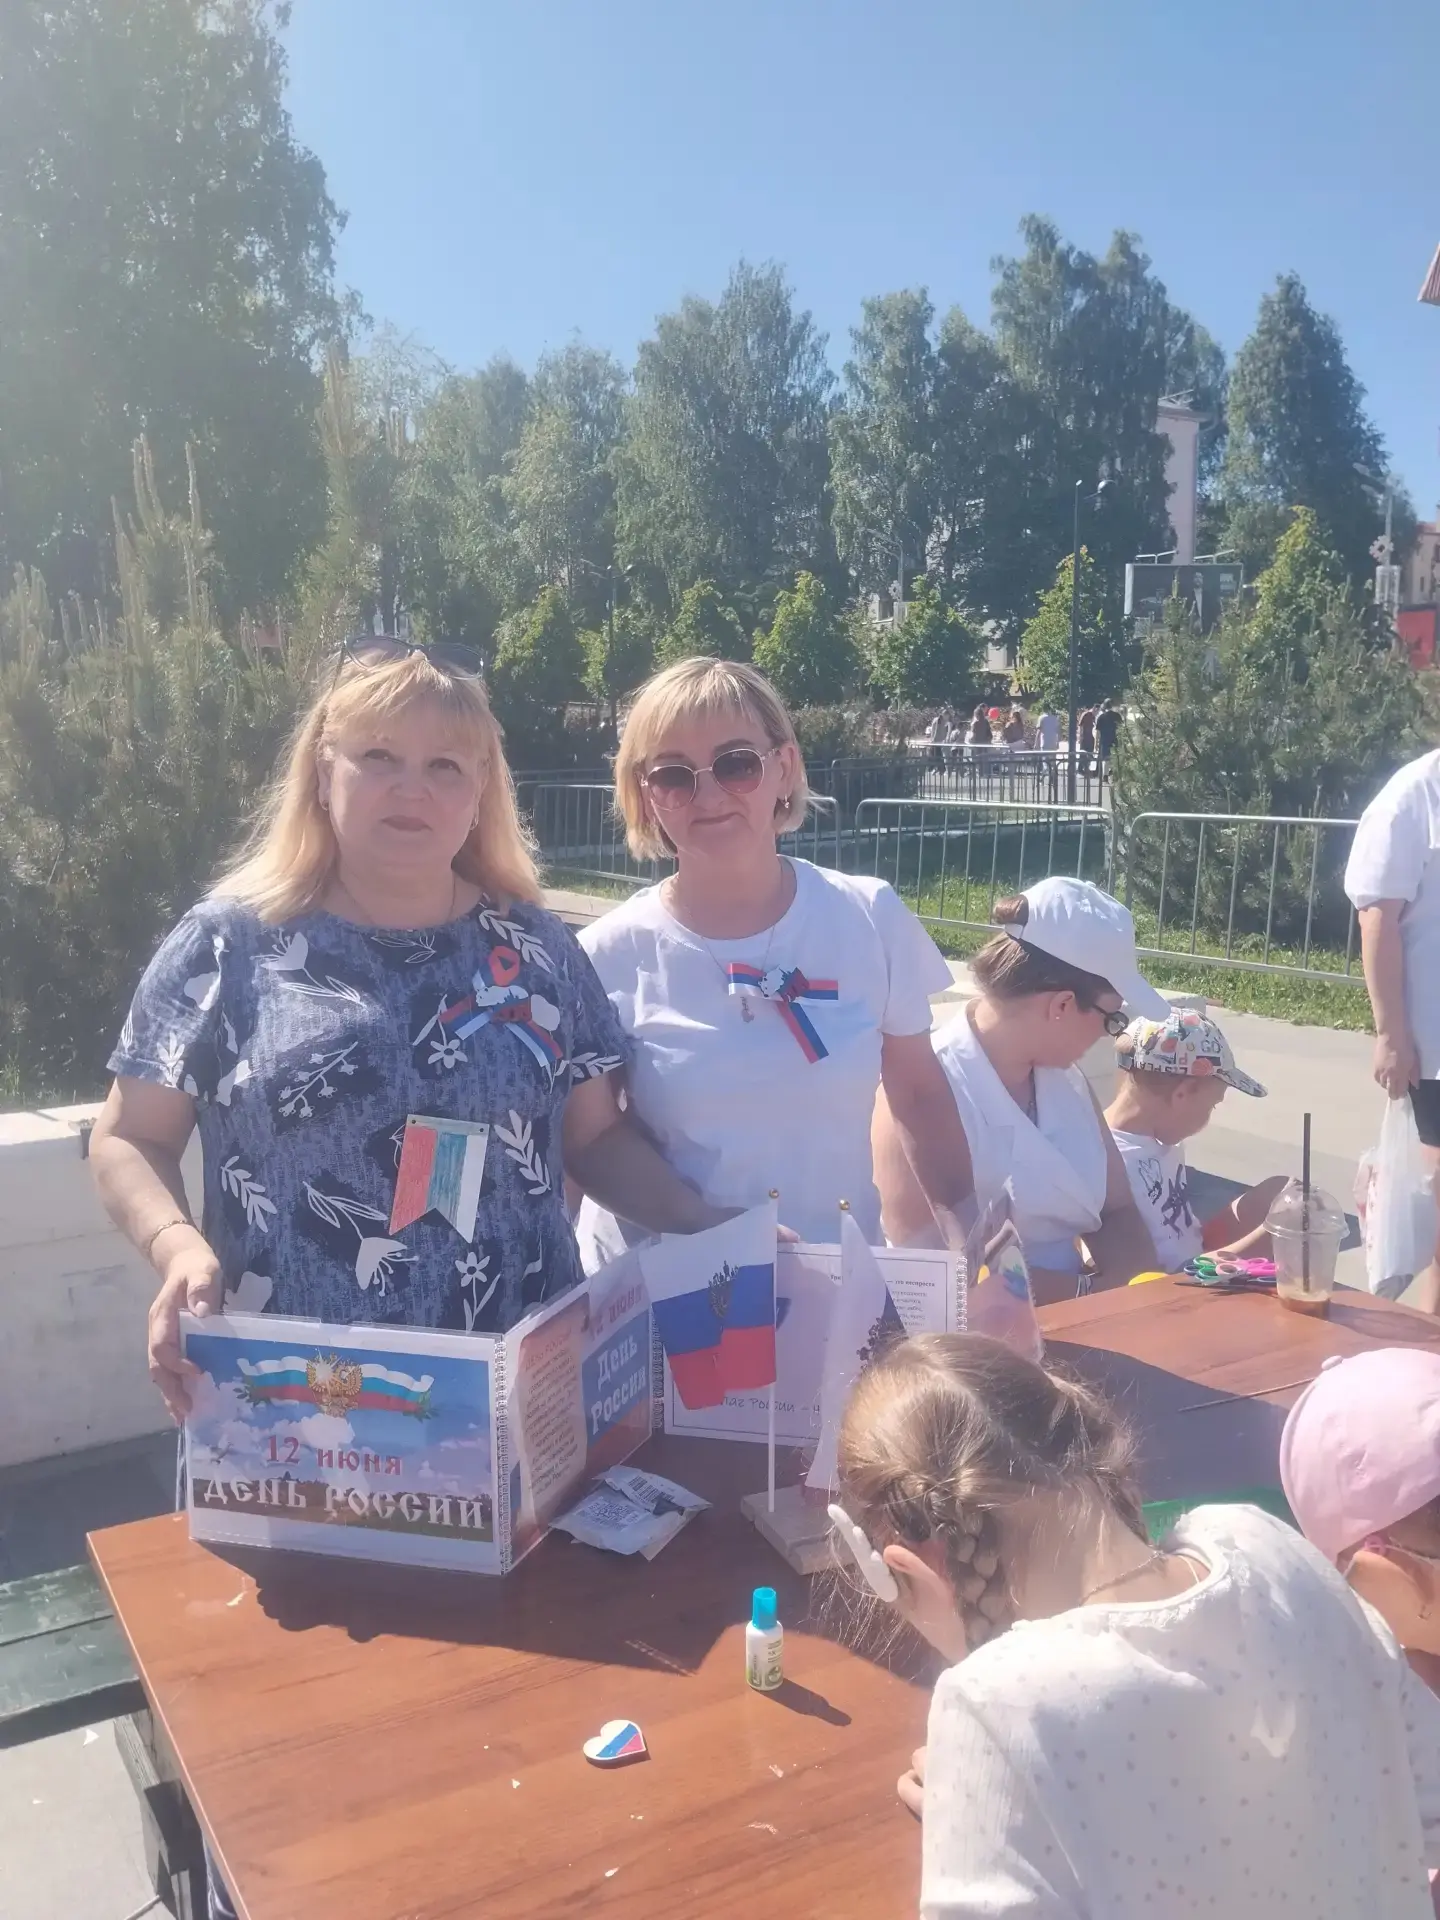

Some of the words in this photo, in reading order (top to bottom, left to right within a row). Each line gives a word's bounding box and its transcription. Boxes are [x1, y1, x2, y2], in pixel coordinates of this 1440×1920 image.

[597, 1334, 638, 1391] День
[591, 1366, 647, 1436] России
[267, 1434, 300, 1464] 12
[317, 1448, 402, 1476] июня
[323, 1483, 485, 1530] РОССИИ
